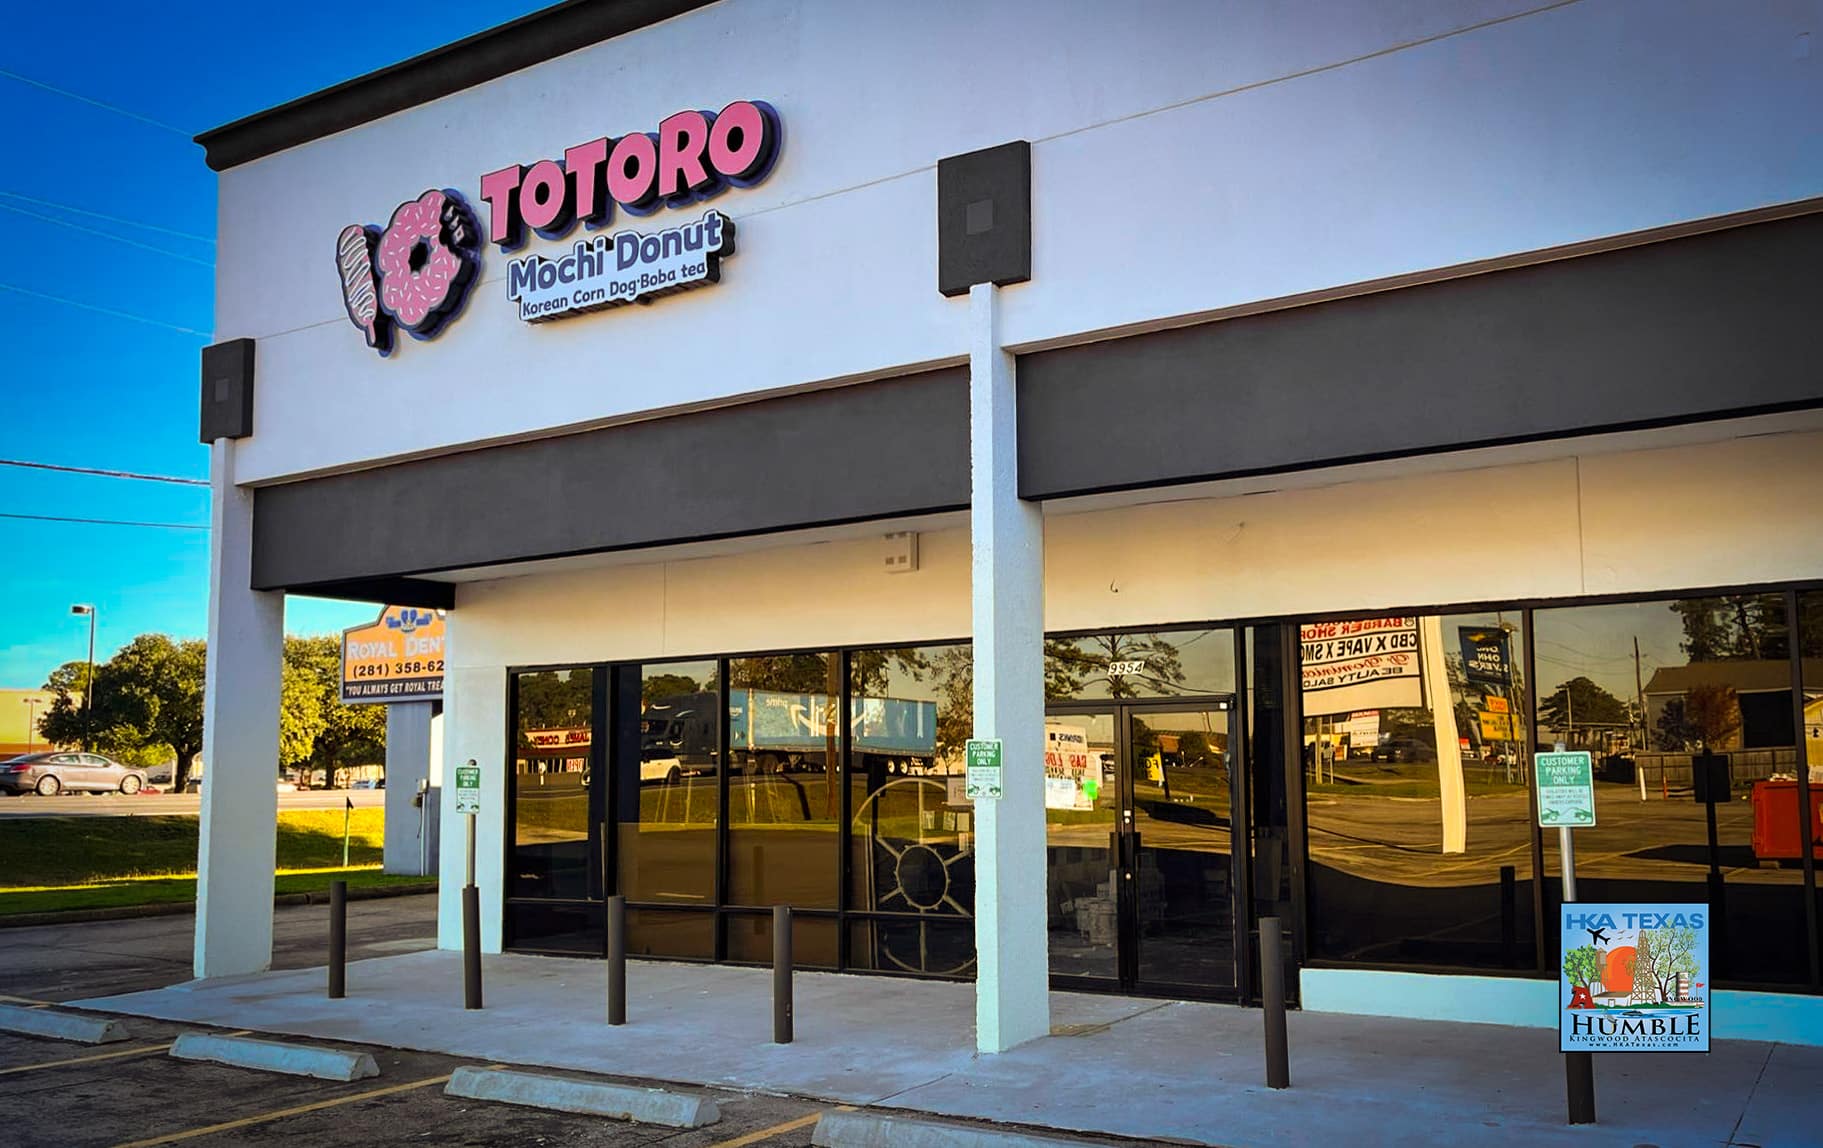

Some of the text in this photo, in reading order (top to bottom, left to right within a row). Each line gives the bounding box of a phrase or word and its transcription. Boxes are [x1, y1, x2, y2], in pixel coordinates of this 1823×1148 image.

[481, 100, 768, 243] TOTORO
[509, 212, 721, 297] Mochi Donut
[522, 296, 568, 317] Korean
[573, 287, 605, 306] Corn
[681, 261, 706, 278] tea
[347, 636, 445, 660] ROYAL DEN
[353, 659, 444, 679] (281) 358-62
[1110, 661, 1144, 674] 9954
[362, 683, 389, 696] ALWAYS
[389, 682, 404, 694] GET
[404, 681, 426, 693] ROYAL
[1540, 756, 1585, 767] CUSTOMER
[1545, 766, 1582, 776] PARKING
[1553, 775, 1575, 784] ONLY
